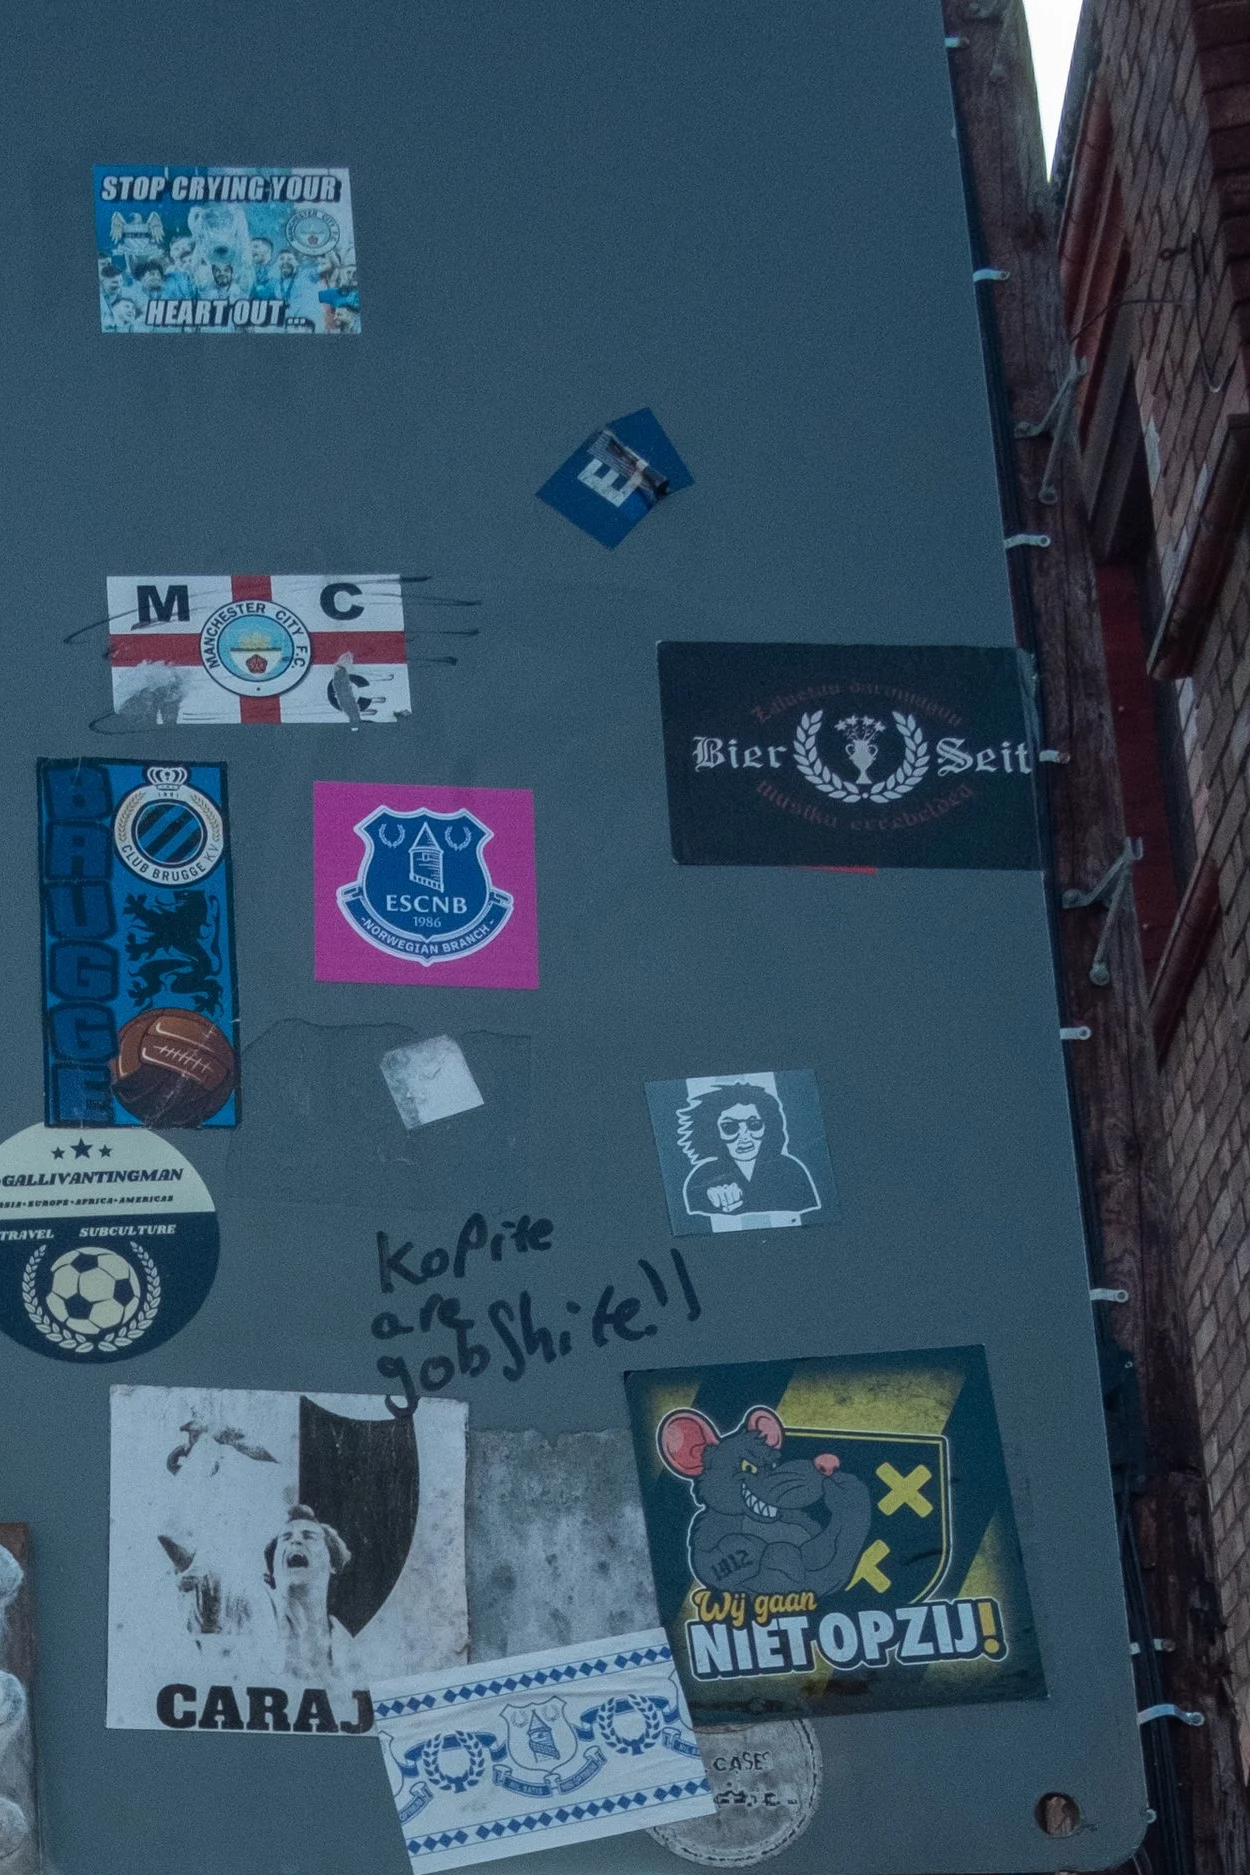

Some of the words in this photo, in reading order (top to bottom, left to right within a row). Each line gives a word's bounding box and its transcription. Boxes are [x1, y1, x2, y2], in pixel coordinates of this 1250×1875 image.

[101, 175, 166, 201] STOP
[171, 174, 265, 202] CRYING
[269, 175, 338, 201] YOUR
[146, 299, 231, 326] HEART
[136, 584, 191, 622] M
[319, 582, 365, 621] C
[203, 602, 267, 670] MANCHESTER
[275, 610, 305, 636] CITY
[292, 645, 308, 669] F.C.
[692, 736, 788, 773] Bier
[121, 844, 149, 873] CLUB
[152, 861, 207, 882] BRUGGE
[203, 843, 220, 863] KV
[386, 894, 468, 915] ESCNB
[412, 916, 442, 929] 1986
[79, 1223, 177, 1238] SUBCULTURE
[692, 1588, 745, 1629] Wij
[753, 1590, 818, 1627] gaan
[690, 1615, 810, 1675] NIET
